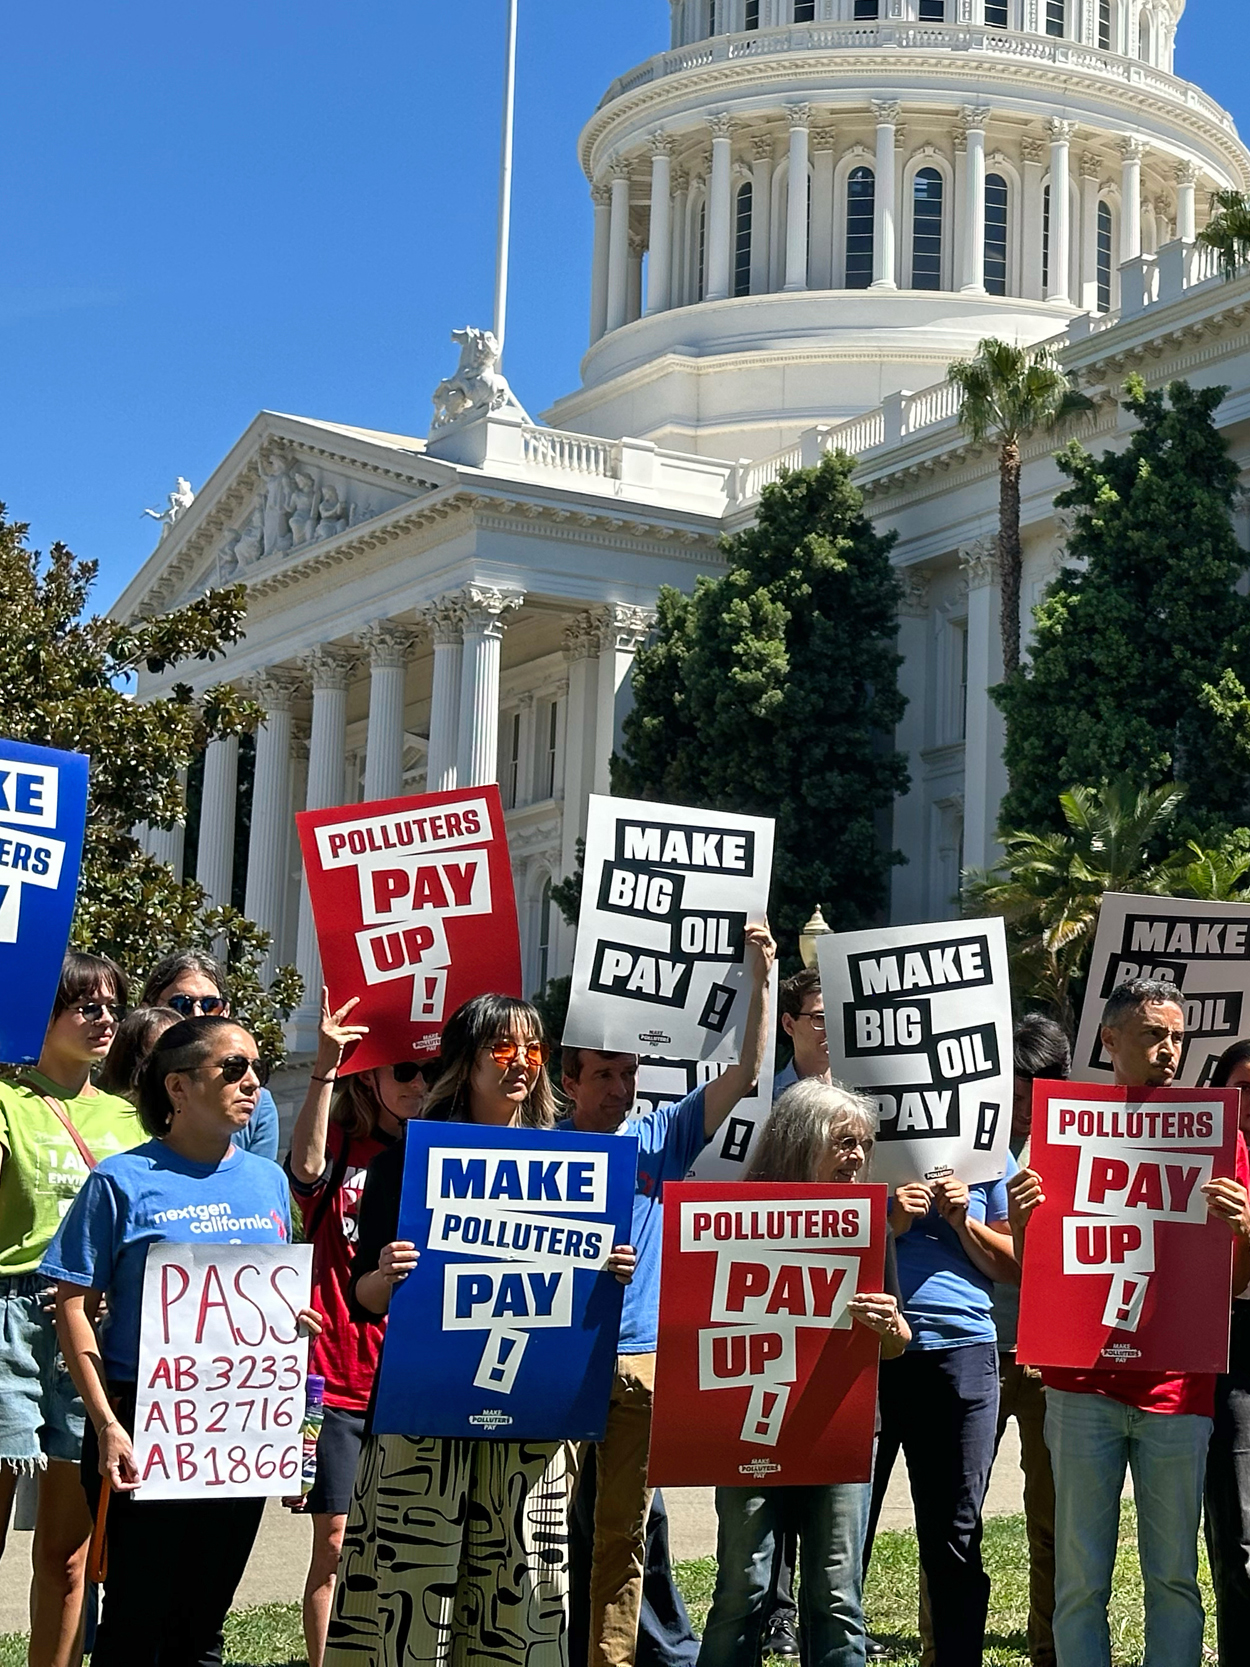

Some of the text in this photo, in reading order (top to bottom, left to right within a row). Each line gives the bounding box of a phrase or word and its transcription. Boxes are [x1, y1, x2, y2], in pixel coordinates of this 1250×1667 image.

[328, 809, 480, 858] POLLUTERS
[624, 825, 746, 869] MAKE
[371, 862, 478, 914] PAY
[608, 869, 673, 915] BIG
[369, 926, 434, 972] UP
[680, 916, 734, 955] OIL
[1131, 921, 1248, 954] MAKE
[599, 948, 686, 998] PAY
[859, 943, 985, 996] MAKE
[422, 977, 438, 1014] !
[708, 990, 729, 1025] !
[855, 1007, 921, 1048] BIG
[937, 1033, 993, 1079] OIL
[981, 1108, 995, 1144] !
[1059, 1109, 1213, 1138] POLLUTERS
[440, 1158, 595, 1202] MAKE
[1087, 1157, 1201, 1212] PAY
[154, 1203, 231, 1224] nextgen
[190, 1214, 273, 1234] california
[693, 1209, 859, 1241] POLLUTERS
[441, 1214, 602, 1259] POLLUTERS
[1075, 1225, 1142, 1265] UP
[161, 1264, 299, 1346] PASS
[455, 1272, 563, 1319] PAY
[725, 1261, 847, 1317] PAY
[1116, 1280, 1138, 1321] !
[488, 1337, 517, 1382] !
[712, 1333, 783, 1378] UP
[754, 1390, 779, 1435] !
